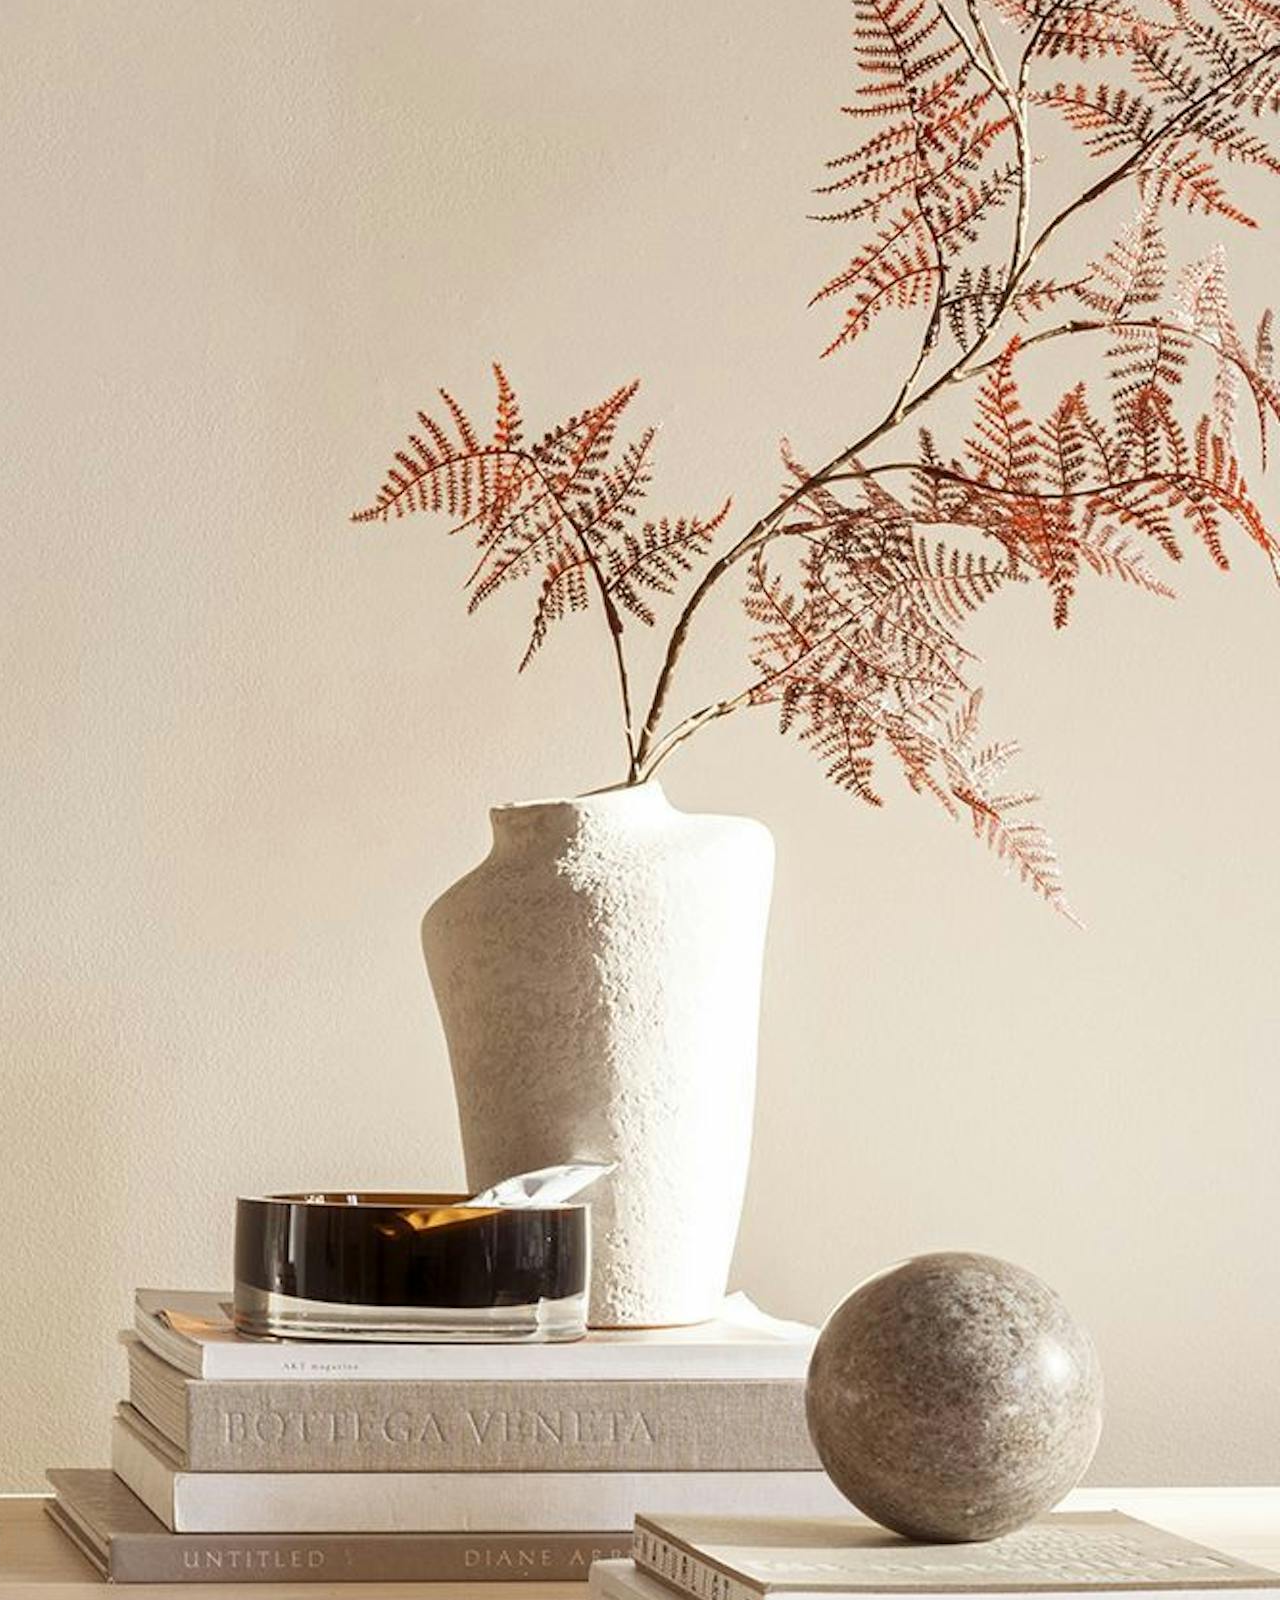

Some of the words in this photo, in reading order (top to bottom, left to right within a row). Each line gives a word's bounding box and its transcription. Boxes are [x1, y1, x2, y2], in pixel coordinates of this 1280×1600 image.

[223, 1409, 447, 1444] BOTTEGA
[465, 1409, 657, 1444] VENETA
[183, 1550, 325, 1568] UNTITLED
[464, 1549, 552, 1567] DIANE
